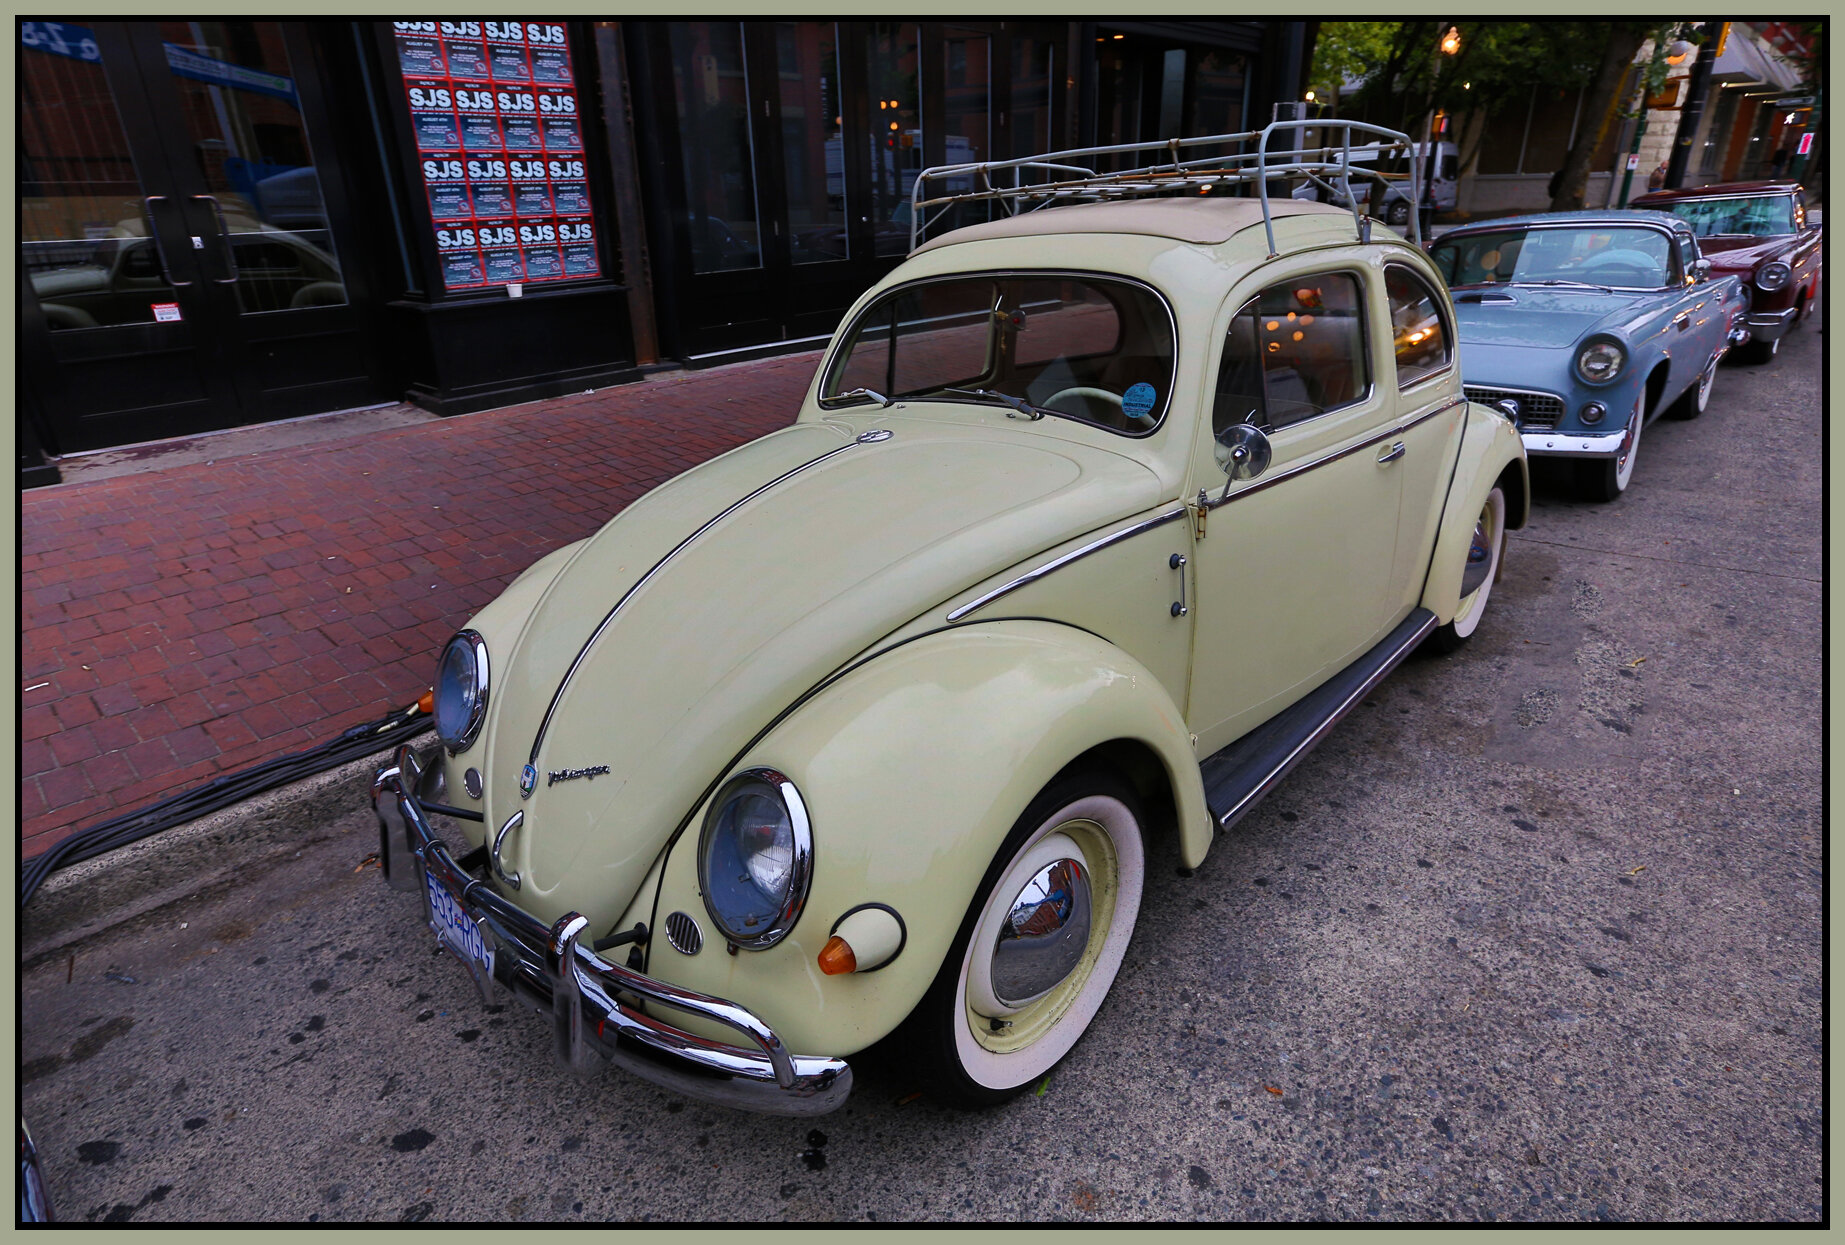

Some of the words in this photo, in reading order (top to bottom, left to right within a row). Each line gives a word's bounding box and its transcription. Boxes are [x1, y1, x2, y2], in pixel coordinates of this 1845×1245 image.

[440, 22, 481, 36] SJS
[485, 22, 523, 40] SJS
[527, 23, 565, 43] SJS
[409, 87, 452, 108] SJS
[455, 90, 494, 109] SJS
[497, 92, 535, 111] SJS
[539, 94, 575, 112] SJS
[423, 160, 464, 178] SJS
[467, 160, 507, 178] SJS
[509, 160, 545, 178] SJS
[548, 160, 584, 177] SJS
[437, 228, 476, 247] SJS
[479, 226, 516, 244] SJS
[519, 225, 555, 242] SJS
[558, 223, 592, 240] SJS
[425, 871, 454, 929] 553
